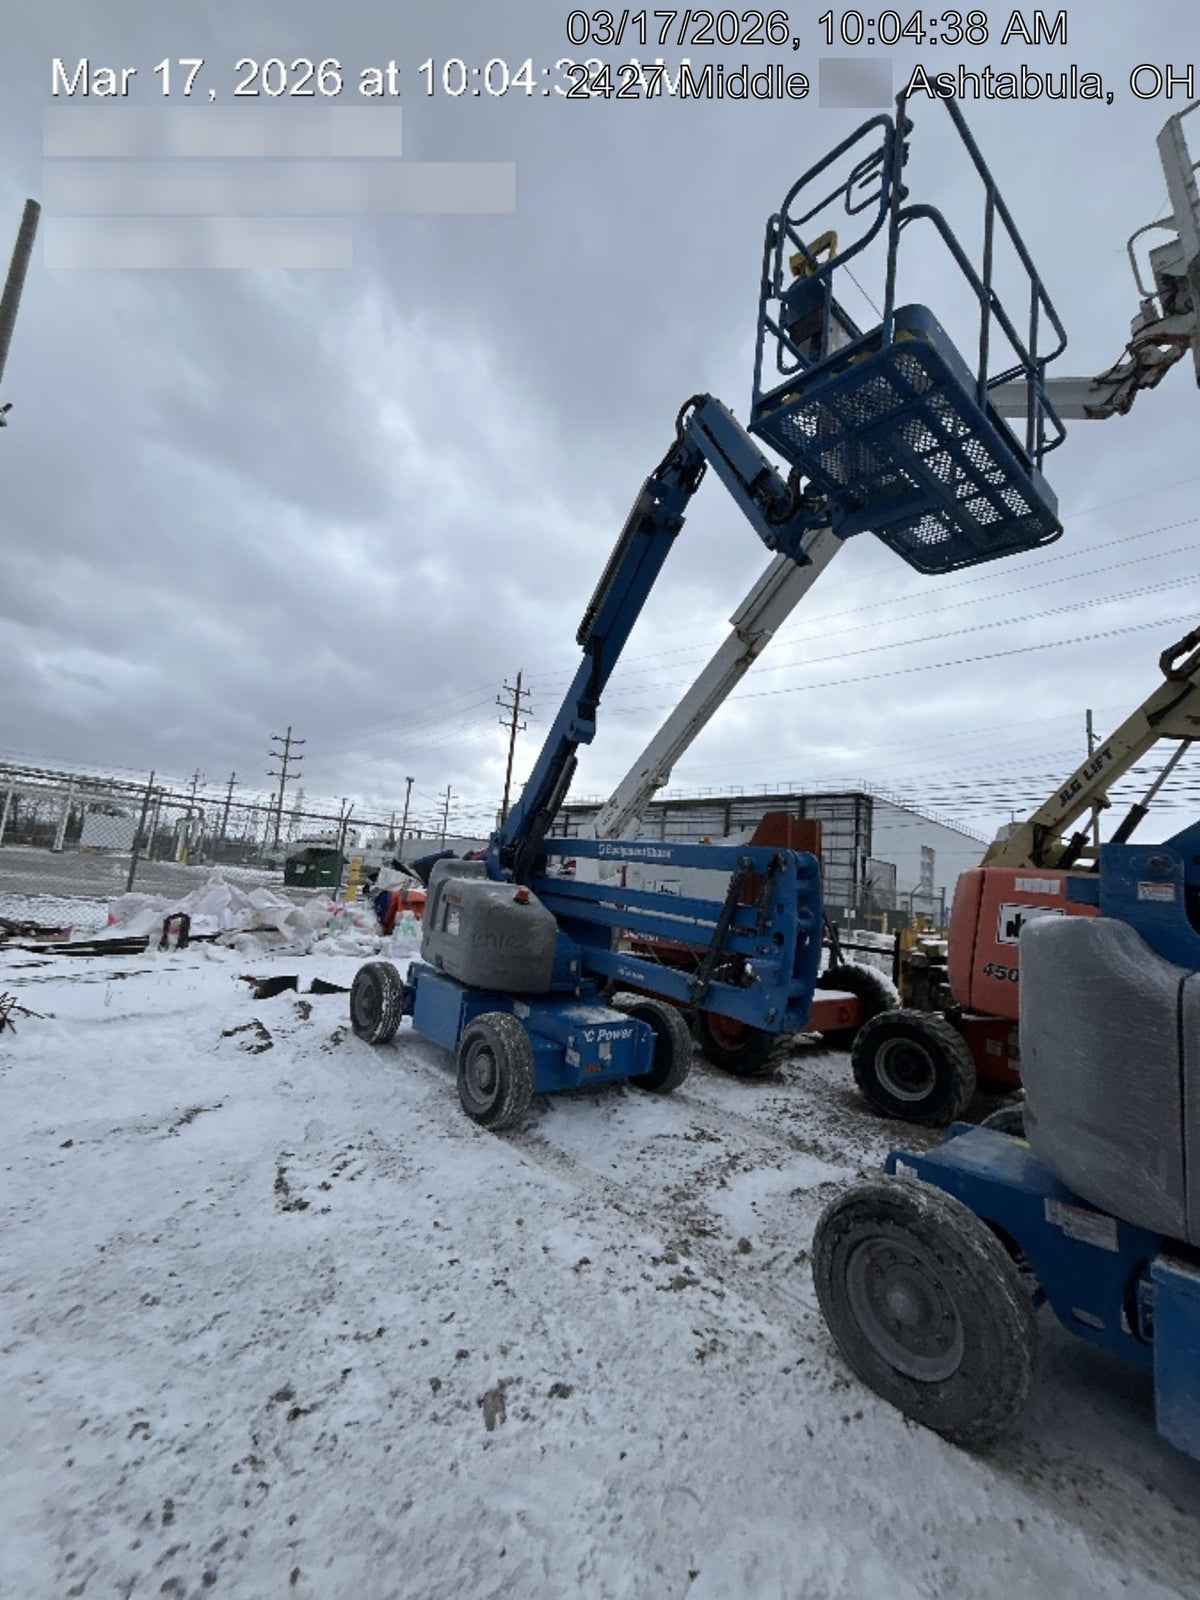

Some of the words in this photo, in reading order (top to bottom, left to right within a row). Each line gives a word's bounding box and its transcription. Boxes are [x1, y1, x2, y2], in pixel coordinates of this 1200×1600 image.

[1059, 779, 1083, 808] JLG
[1082, 746, 1113, 781] LIFT
[597, 1028, 634, 1042] Power
